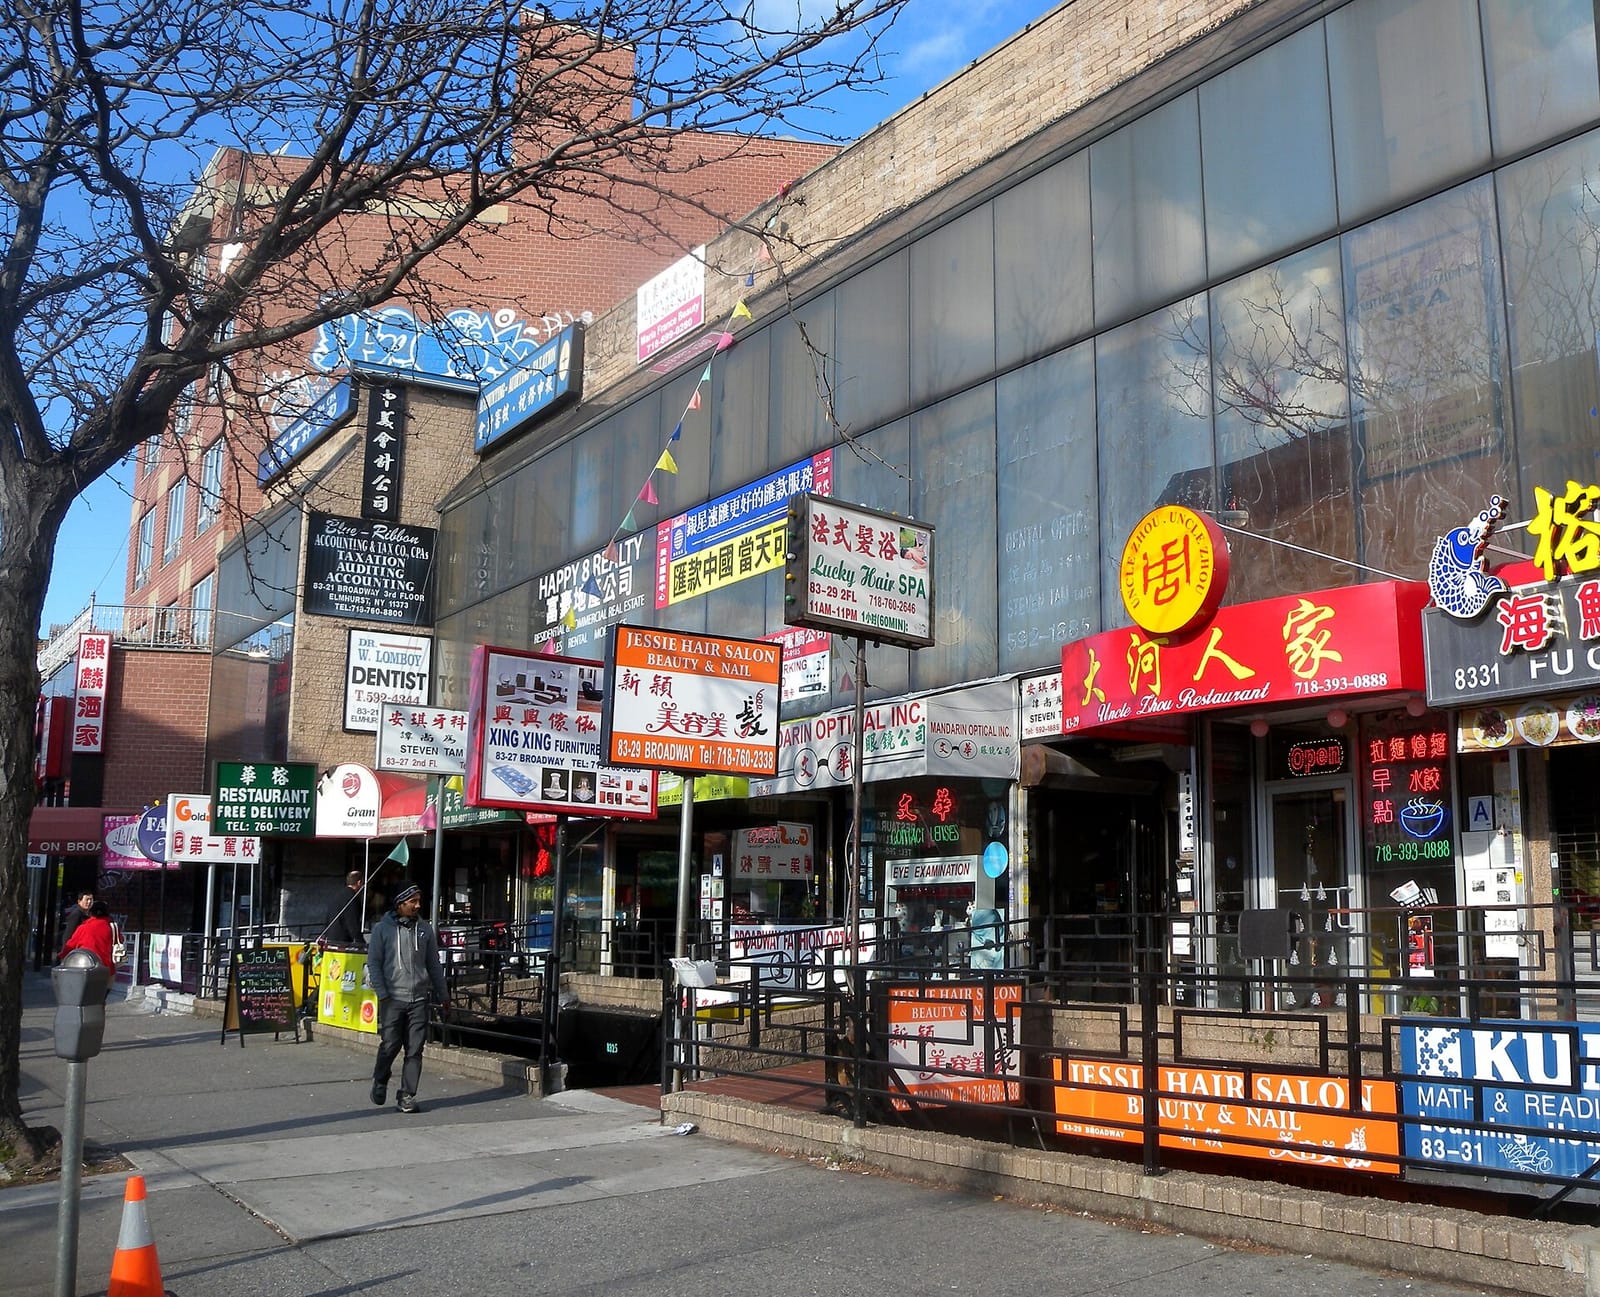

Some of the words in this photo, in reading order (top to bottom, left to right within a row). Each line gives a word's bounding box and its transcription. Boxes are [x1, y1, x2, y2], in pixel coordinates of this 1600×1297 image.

[371, 389, 398, 513] 中美會計公司
[325, 518, 357, 536] Blue
[371, 524, 420, 545] Ribbon
[314, 534, 368, 553] ACCOUNTING
[370, 540, 376, 553] &
[378, 541, 393, 556] TAX
[337, 549, 406, 568] TAXATION
[336, 562, 405, 579] AUDITING
[538, 561, 580, 600] HAPPY
[582, 558, 589, 581] 8
[810, 554, 857, 587] Lucky
[860, 564, 895, 592] Hair
[898, 573, 927, 600] SPA
[325, 572, 415, 592] ACCOUNTING
[809, 582, 838, 598] 83-29
[841, 590, 857, 603] 2FL
[329, 593, 372, 606] ELMHURST,
[374, 598, 385, 606] NY
[389, 600, 409, 609] 11373
[337, 585, 380, 596] BROADWAY
[384, 590, 396, 599] 3rd
[399, 592, 425, 602] FLOOR
[608, 604, 622, 618] REAL
[624, 594, 645, 612] ESTATE
[809, 601, 858, 621] 11AM-11PM
[869, 594, 916, 615] 718-760-2646
[568, 632, 588, 649] RENTAL
[625, 632, 677, 651] JESSIE
[681, 640, 721, 657] HAIR
[725, 645, 776, 664] SALON
[375, 650, 422, 667] LOMBOY
[1081, 598, 1343, 707] 大河人家
[647, 653, 699, 670] BEAUTY
[704, 661, 716, 673] &
[721, 662, 752, 677] NAIL
[1454, 662, 1501, 691] 8331
[1530, 647, 1574, 680] FU
[351, 666, 427, 691] DENTIST
[1026, 677, 1063, 696] 安琪牙
[1294, 672, 1389, 696] 718-393-0888
[75, 637, 106, 747] 麒麟酒家
[1098, 701, 1132, 723] Uncle
[1139, 693, 1173, 716] Zhou
[1178, 682, 1271, 712] Restaurant
[388, 709, 467, 731] 安琪牙科
[890, 702, 927, 727] INC.
[1030, 711, 1056, 723] STEVEN
[930, 721, 967, 737] MANDARIN
[968, 722, 998, 737] OPTICAL
[998, 725, 1012, 738] INC.
[400, 744, 439, 756] STEVEN
[444, 747, 464, 757] TAM
[489, 727, 519, 748] XING
[522, 731, 552, 751] XING
[554, 739, 601, 756] FURNITURE
[386, 757, 409, 766] 83-27
[412, 758, 426, 767] 2nd
[495, 751, 518, 762] 83-27
[519, 753, 565, 767] BROADWAY
[571, 759, 589, 769] TEL:
[617, 739, 641, 758] 83-29
[644, 741, 695, 762] BROADWAY
[699, 745, 715, 765] Tel:
[717, 747, 774, 769] 718-760-2338
[1290, 745, 1341, 773] Open
[219, 787, 309, 804] RESTAURANT
[217, 805, 246, 819] FREE
[250, 805, 311, 820] DELIVERY
[347, 806, 376, 818] Gram
[1473, 800, 1489, 822] A
[226, 821, 250, 832] TEL:
[254, 822, 301, 833] 760-1027
[40, 841, 60, 852] ON
[1375, 839, 1450, 863] 718-393-0888
[892, 866, 909, 879] EYE
[914, 862, 970, 878] EXAMINATION
[734, 930, 781, 949] BROADWAY
[783, 930, 824, 950] FAHION
[940, 988, 972, 1000] HAIR
[976, 986, 1018, 1000] SLON
[912, 1006, 955, 1019] BEAUTY
[1069, 1063, 1143, 1091] JESSI
[1166, 1071, 1245, 1099] HAIR
[1494, 1091, 1509, 1113] &
[1217, 1104, 1235, 1125] &
[1246, 1107, 1302, 1132] NAIL
[1084, 1126, 1125, 1139] BROADWAY
[1421, 1137, 1483, 1163] 83-31
